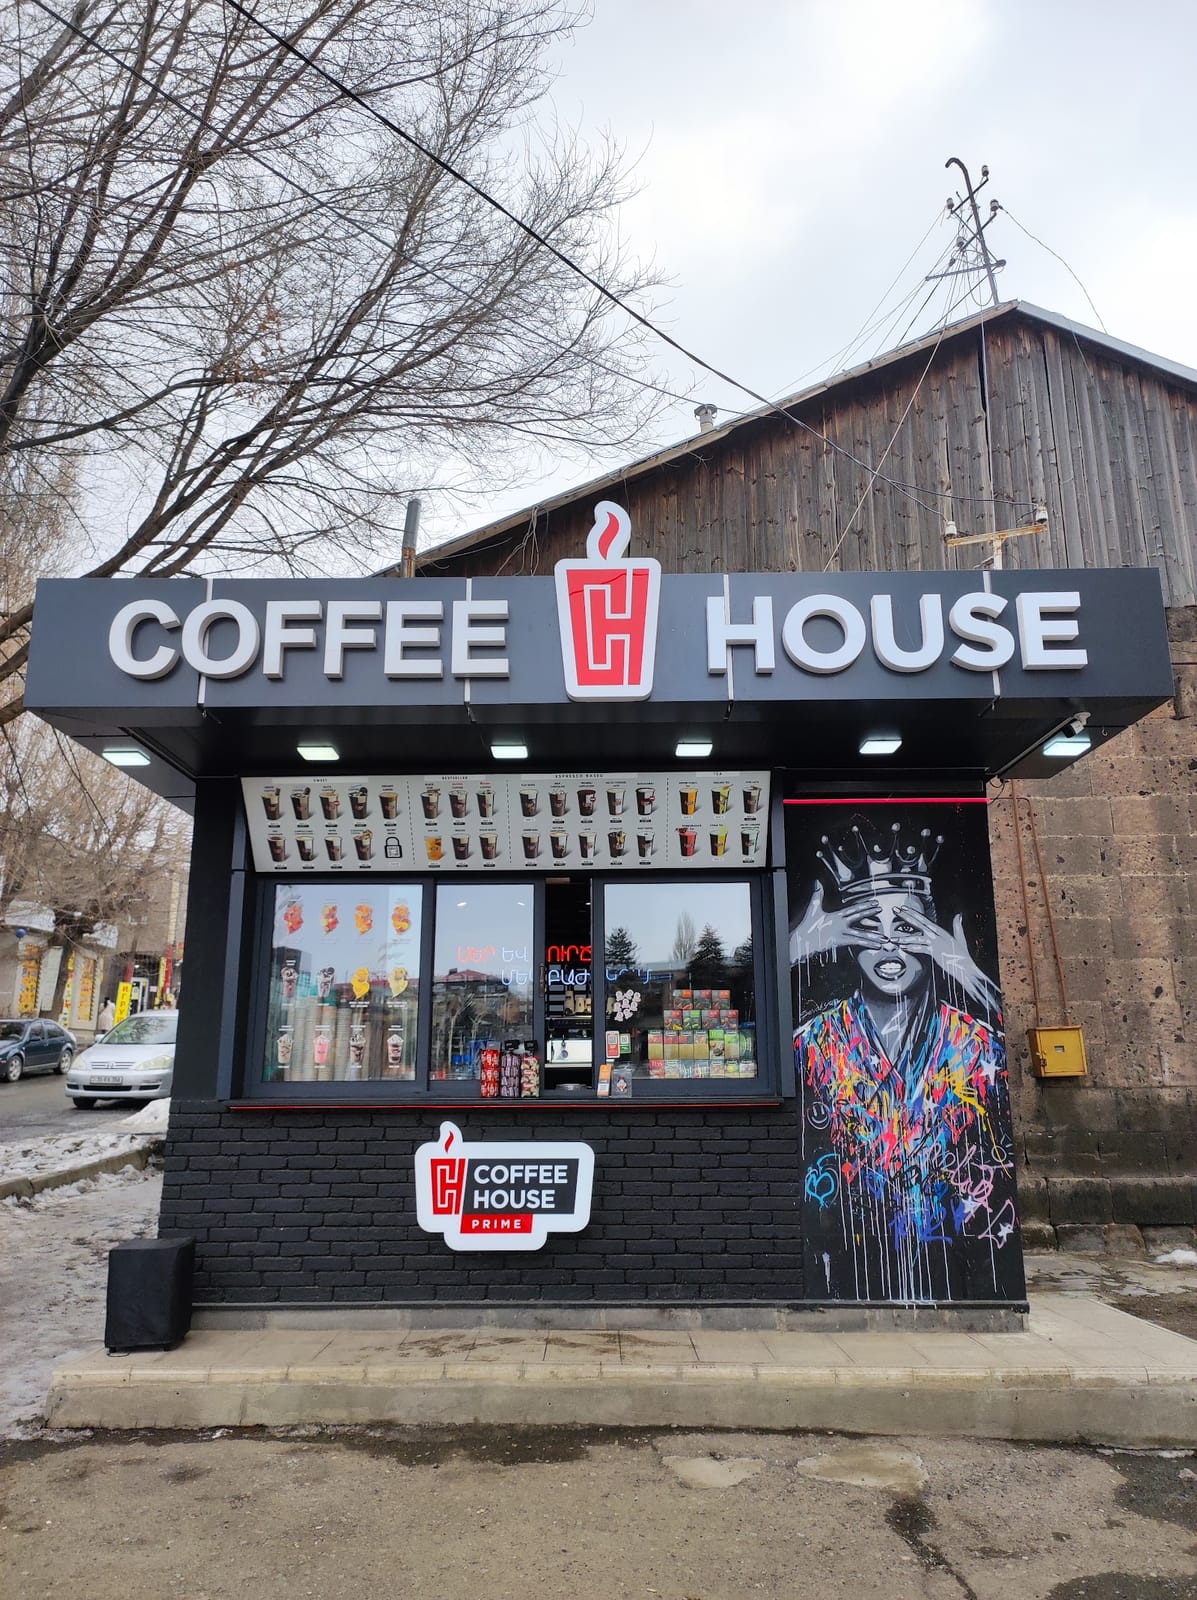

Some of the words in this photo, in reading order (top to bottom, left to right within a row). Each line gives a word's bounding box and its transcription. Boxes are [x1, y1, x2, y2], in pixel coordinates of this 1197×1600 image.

[108, 599, 509, 679] COFFEE
[706, 592, 1088, 675] HOUSE
[547, 944, 592, 962] ՈՒՐՃ
[502, 968, 534, 986] ՄԵ
[473, 1165, 568, 1184] COFFEE
[473, 1189, 556, 1209] HOUSE
[471, 1219, 522, 1229] PRIME
